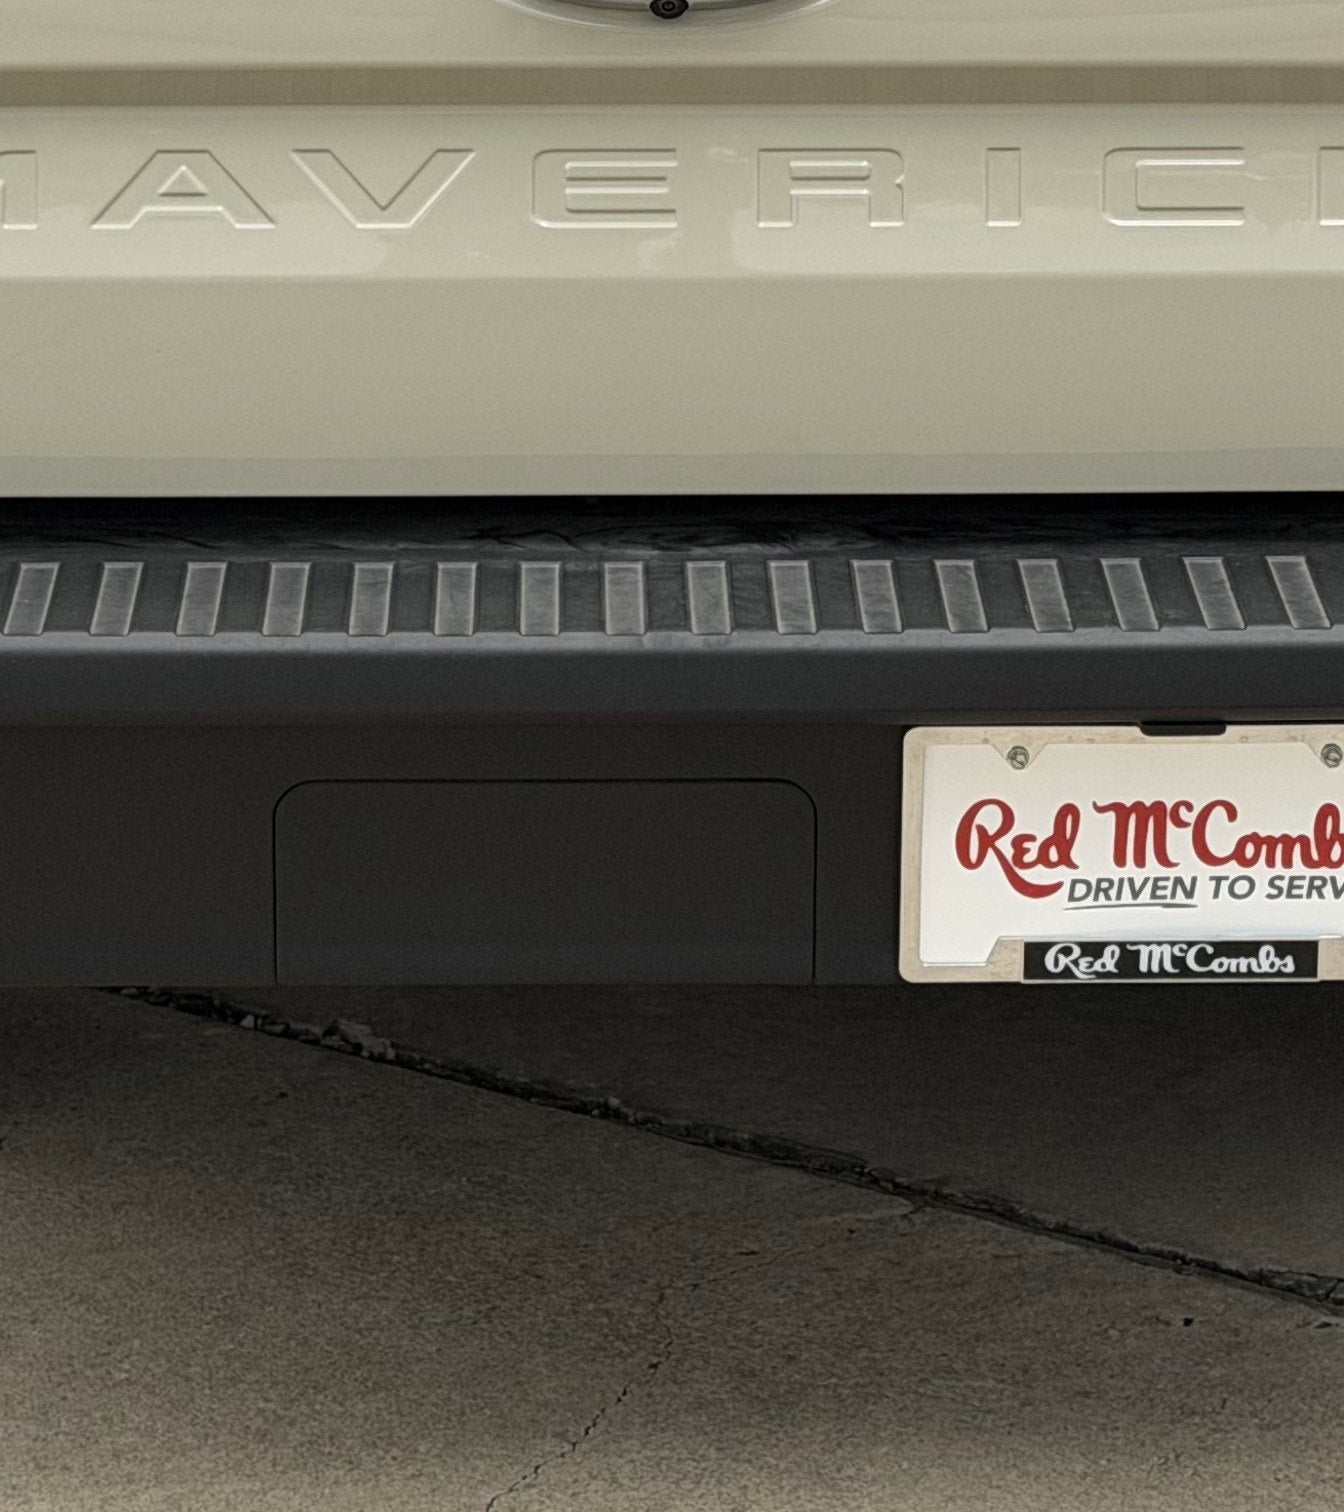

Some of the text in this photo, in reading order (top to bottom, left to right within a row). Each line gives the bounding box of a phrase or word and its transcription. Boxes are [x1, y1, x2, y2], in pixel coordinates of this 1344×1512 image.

[956, 798, 1081, 898] Red
[1067, 875, 1197, 902] DRIVEN
[1208, 874, 1257, 900] TO
[1045, 942, 1295, 979] Red McCombs
